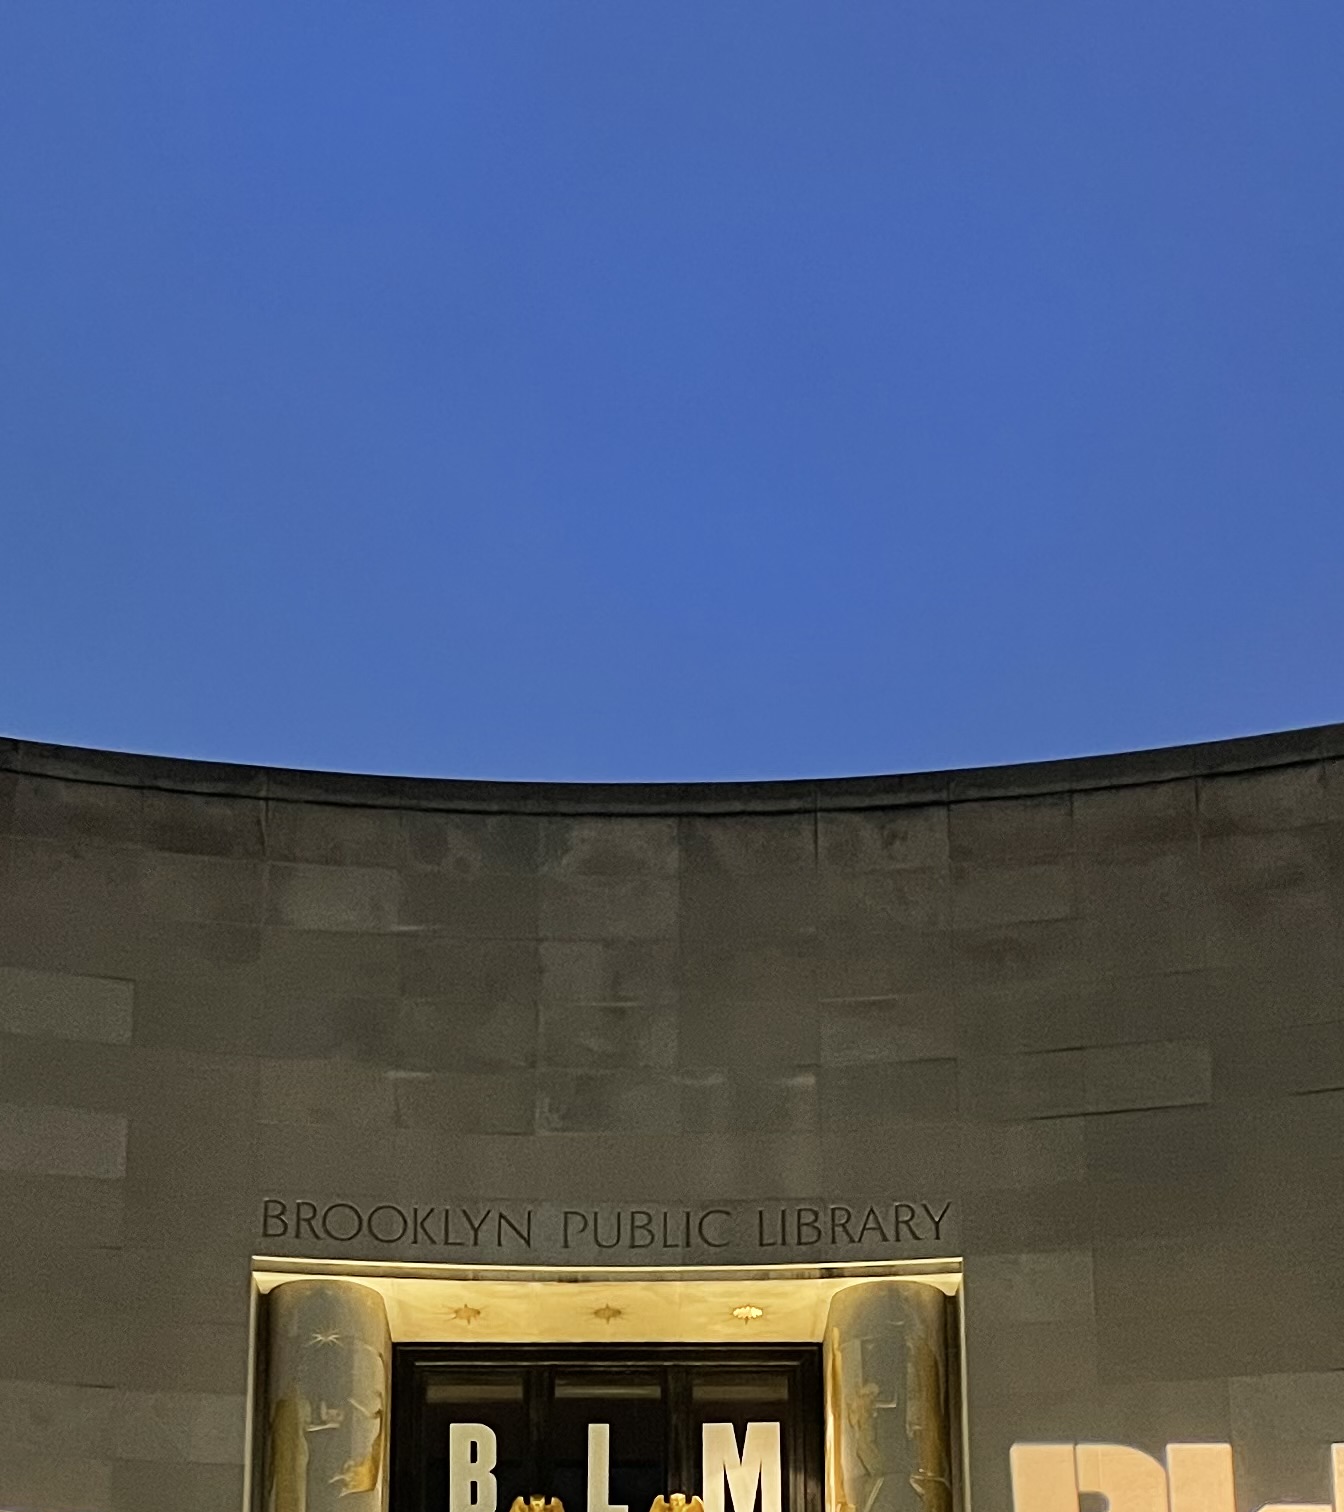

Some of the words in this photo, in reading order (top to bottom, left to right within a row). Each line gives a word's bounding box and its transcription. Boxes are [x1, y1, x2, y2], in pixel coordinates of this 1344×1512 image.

[261, 1198, 533, 1249] BROOKLYN
[562, 1208, 731, 1250] PUBLIC
[757, 1201, 953, 1247] LIBRARY
